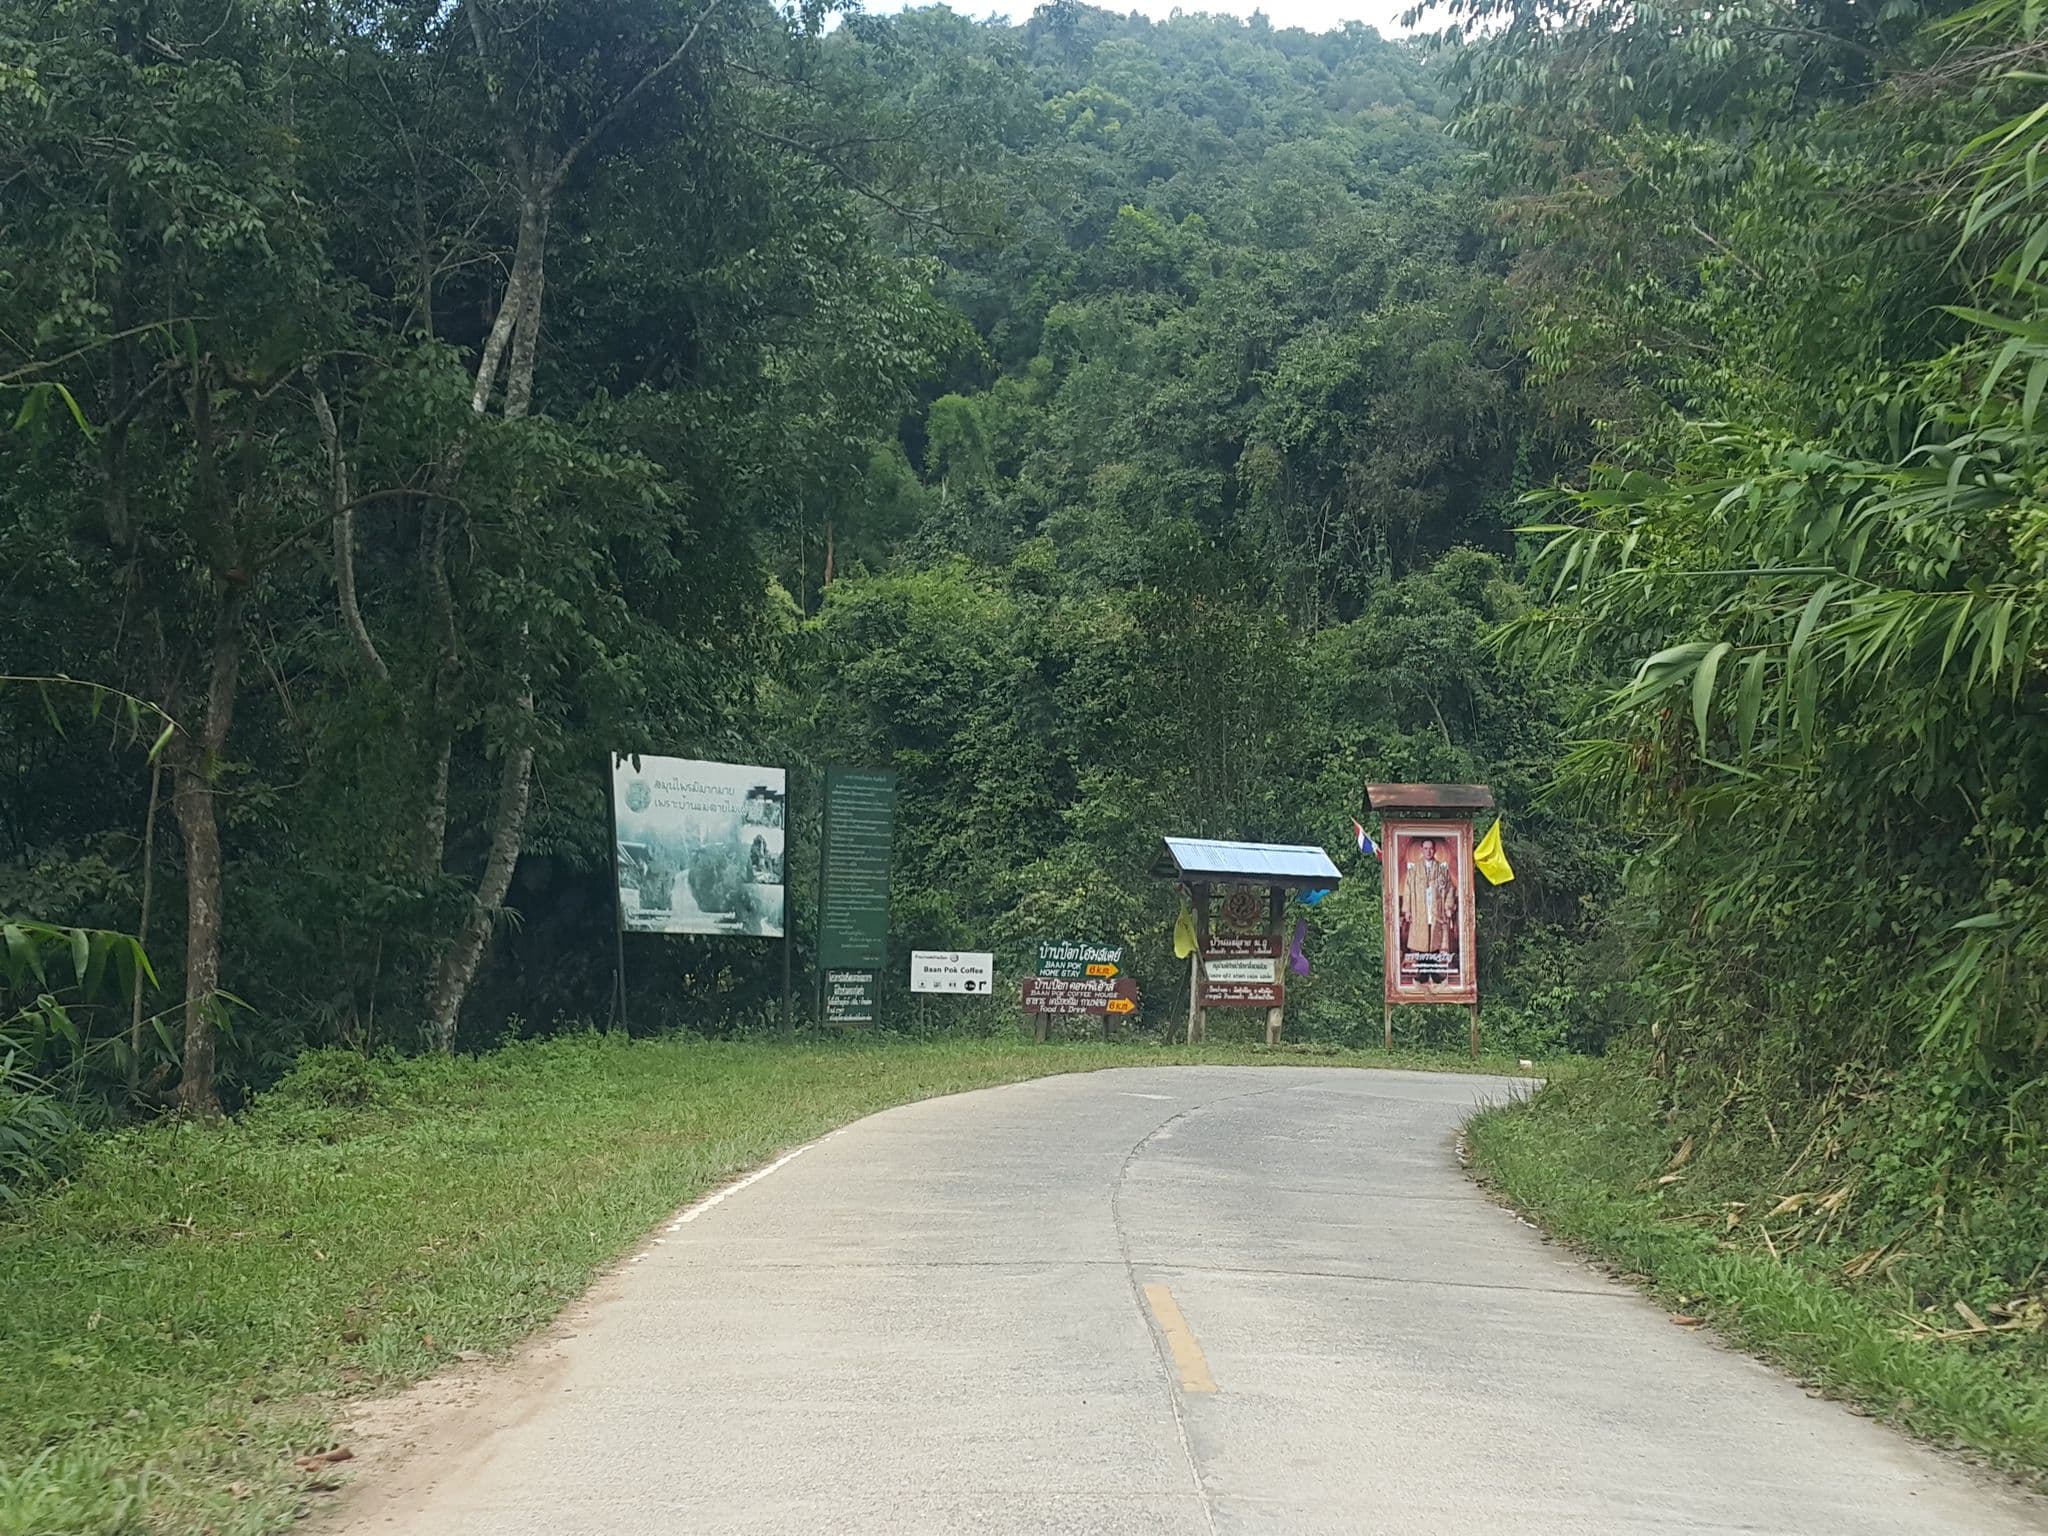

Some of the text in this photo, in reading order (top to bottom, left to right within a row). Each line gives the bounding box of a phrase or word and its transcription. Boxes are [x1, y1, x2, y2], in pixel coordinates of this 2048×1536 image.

[1045, 961, 1082, 970] BAAN POK
[960, 966, 983, 974] Coffee
[1061, 969, 1080, 977] STAY
[1039, 1005, 1057, 1013] Food
